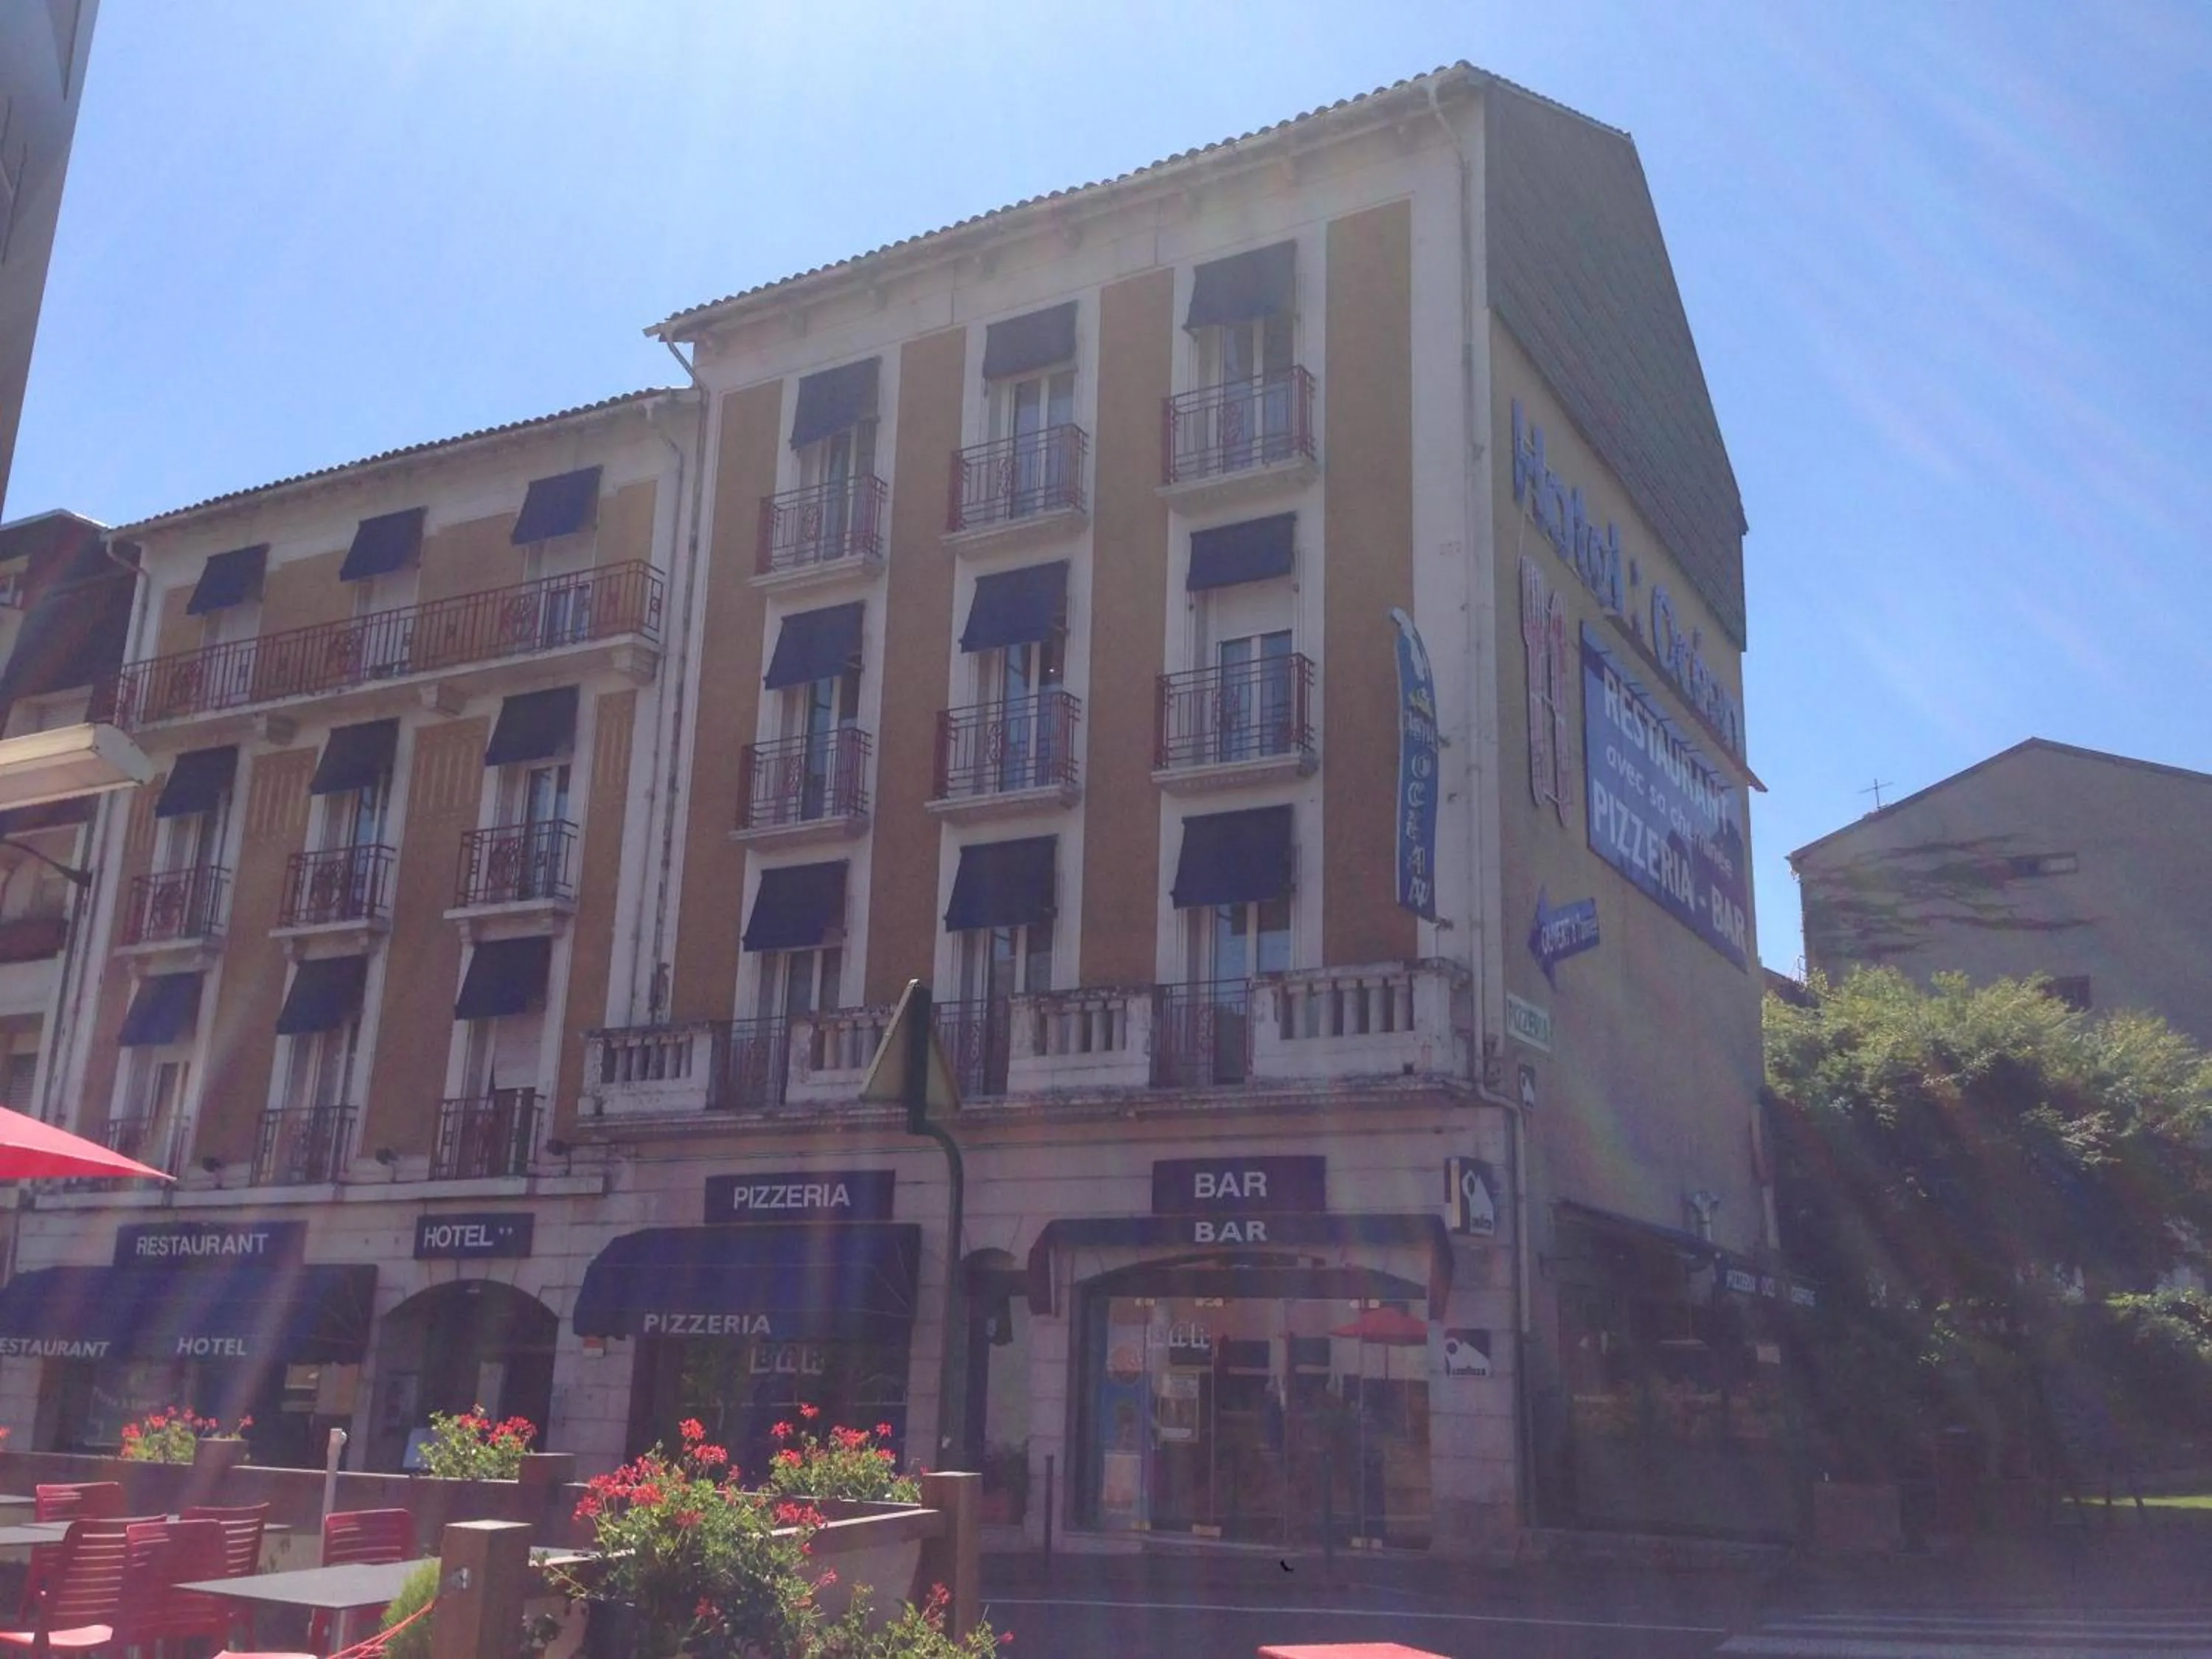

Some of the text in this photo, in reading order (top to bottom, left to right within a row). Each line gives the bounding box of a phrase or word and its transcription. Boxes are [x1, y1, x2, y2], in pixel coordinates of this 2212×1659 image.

[1604, 665, 1728, 838] RESTAURANT
[1607, 743, 1645, 796] avec
[1649, 783, 1666, 816] sa
[1593, 776, 1697, 915] PIZZERIA
[1711, 883, 1747, 956] BAR
[733, 1183, 851, 1210] PIZZERIA
[1194, 1171, 1267, 1198] BAR
[424, 1224, 494, 1248] HOTEL
[1194, 1220, 1268, 1242] BAR
[136, 1233, 269, 1256] RESTAURANT
[643, 1313, 771, 1335] PIZZERIA
[176, 1337, 248, 1356] HOTEL
